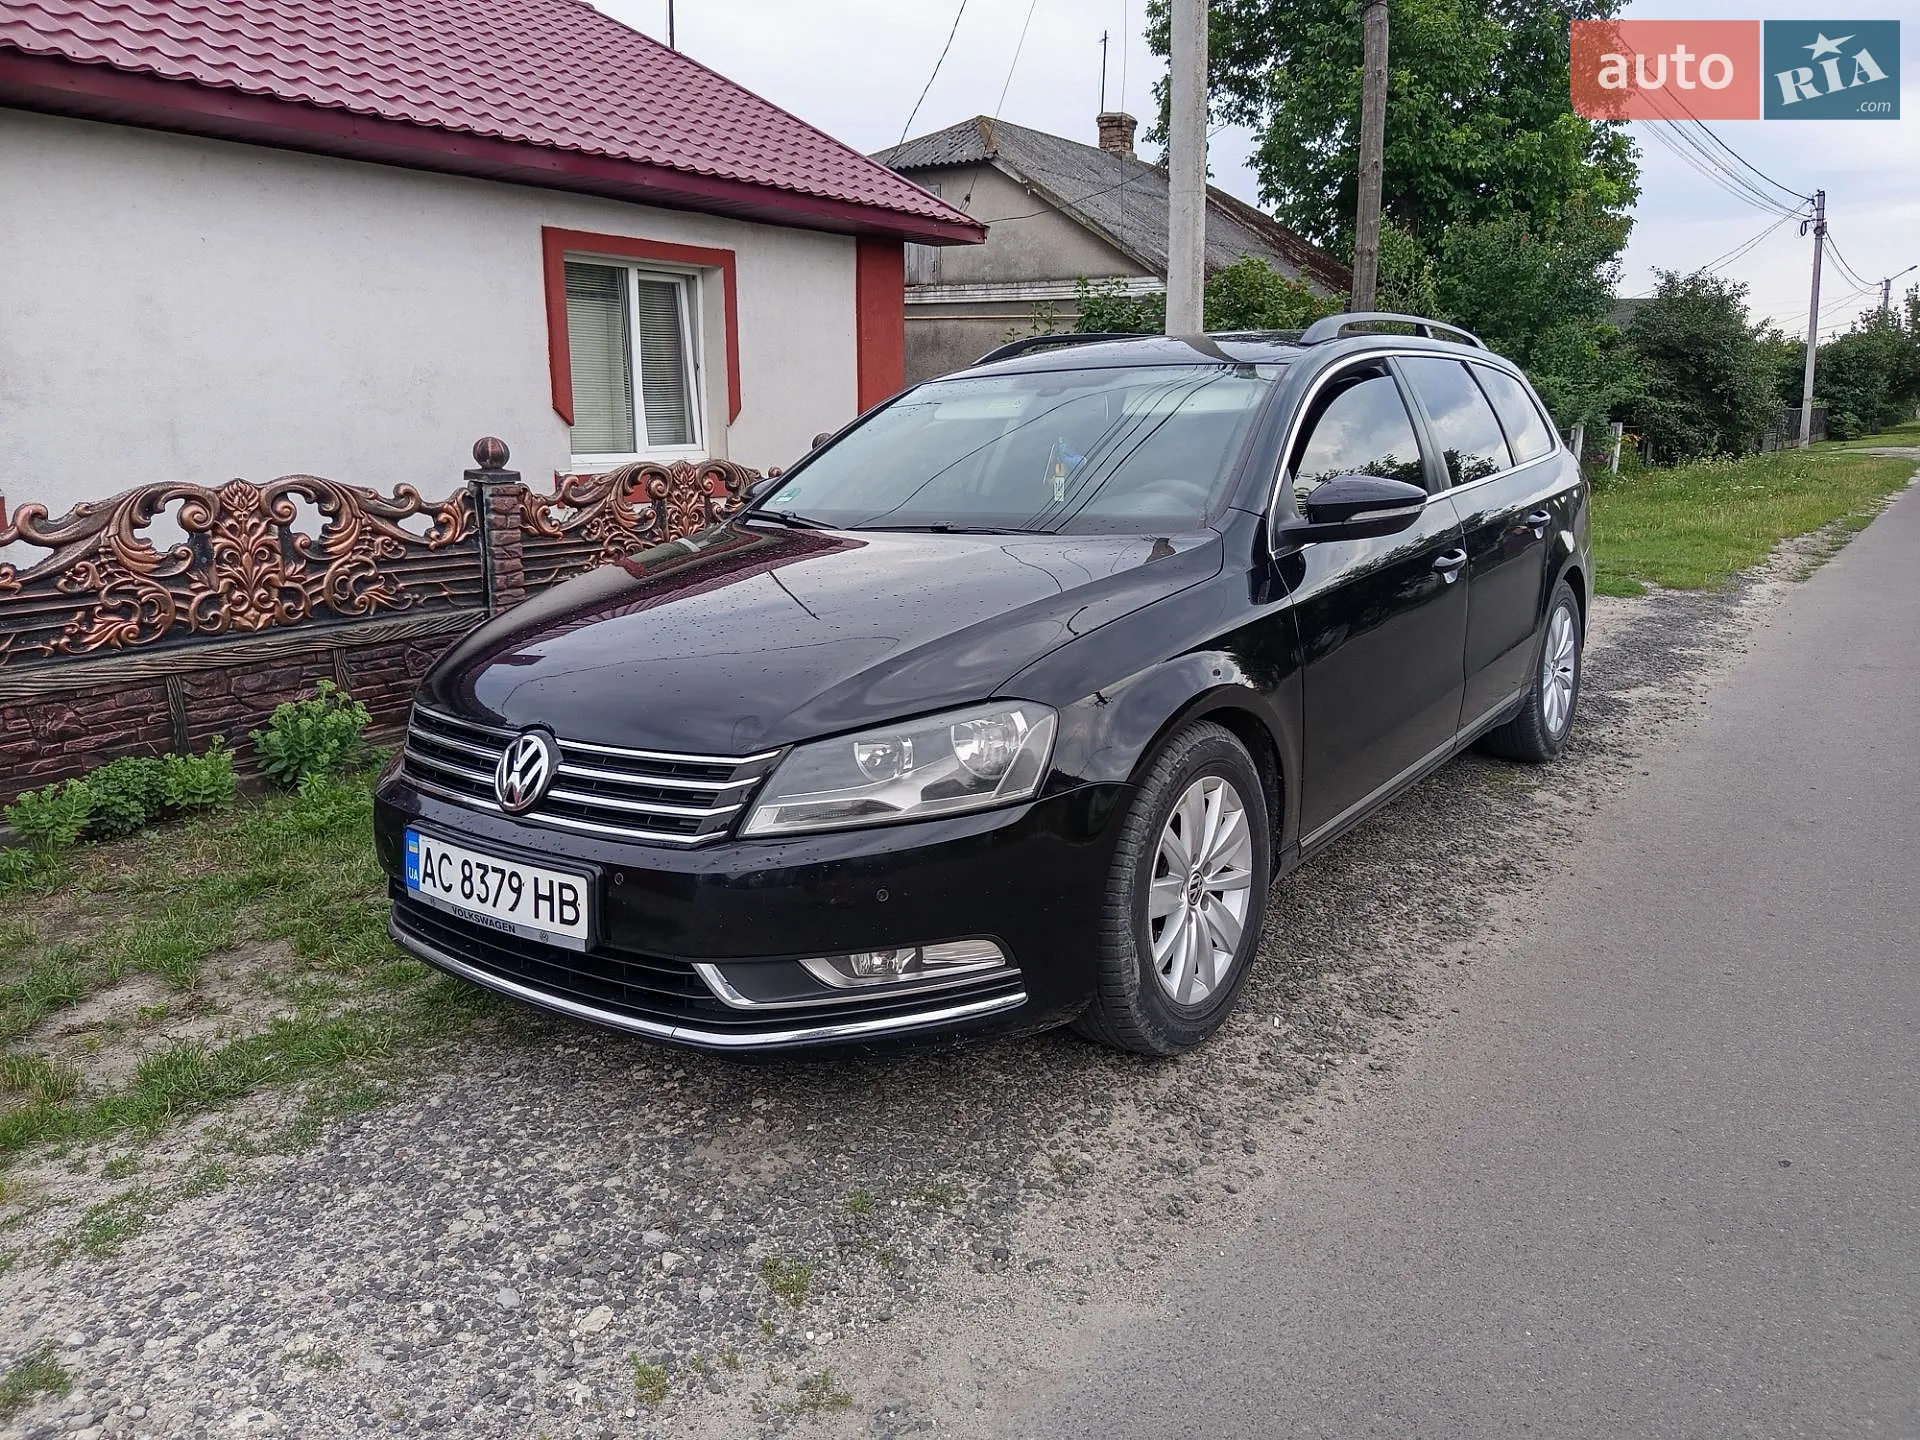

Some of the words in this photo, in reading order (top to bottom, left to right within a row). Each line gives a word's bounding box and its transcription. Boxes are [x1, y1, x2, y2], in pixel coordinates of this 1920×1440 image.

[408, 867, 419, 881] UA
[421, 846, 454, 893] AC
[460, 858, 523, 912] 8379
[533, 876, 581, 926] HB
[452, 906, 516, 934] VOLKSWAGEN
